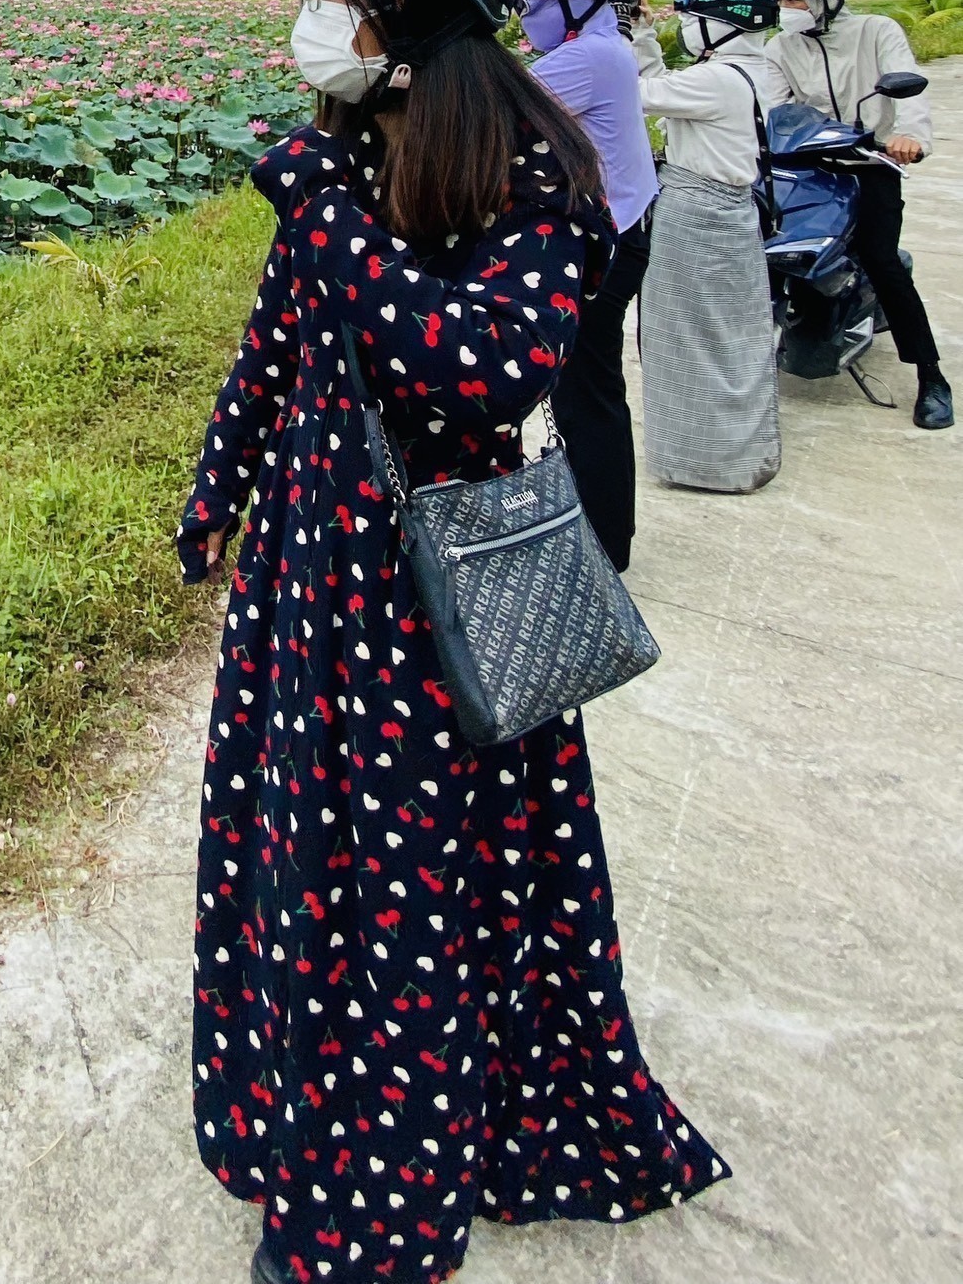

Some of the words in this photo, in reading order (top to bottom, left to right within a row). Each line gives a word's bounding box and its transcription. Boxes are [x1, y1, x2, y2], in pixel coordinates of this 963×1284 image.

[500, 488, 538, 512] REACTION
[484, 586, 516, 659] REACTION
[494, 640, 527, 717] REACTION
[518, 569, 547, 641] REACTION
[527, 611, 557, 685] REACTION
[549, 541, 575, 612] REACTION
[555, 593, 583, 665] REACTION
[585, 615, 615, 684] REACTION
